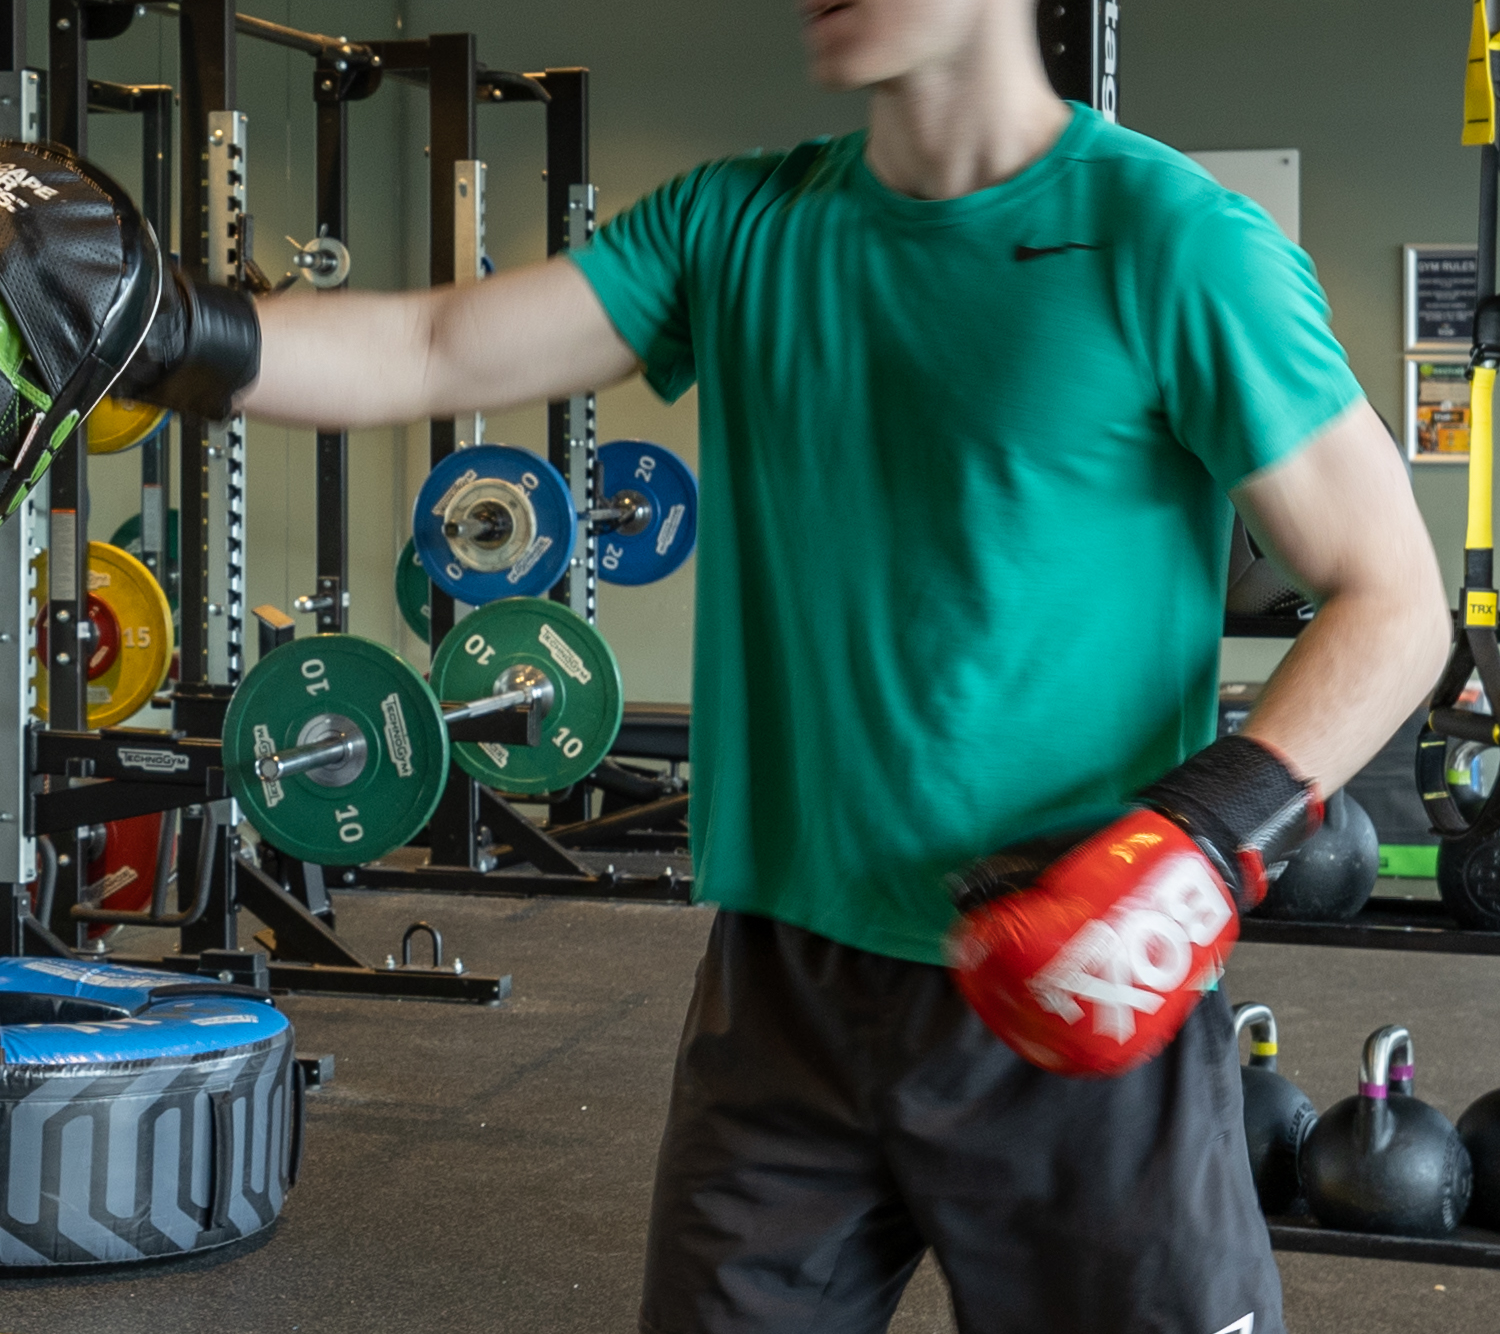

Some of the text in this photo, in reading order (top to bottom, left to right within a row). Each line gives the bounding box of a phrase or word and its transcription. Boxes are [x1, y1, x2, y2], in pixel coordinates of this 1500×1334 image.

[1418, 261, 1440, 272] GYM
[634, 455, 656, 484] 20
[601, 543, 625, 571] 20
[1470, 604, 1493, 615] TRX
[123, 626, 151, 649] 15
[464, 633, 497, 667] 10
[300, 658, 331, 697] 10
[552, 726, 585, 759] 10
[334, 804, 364, 844] 10
